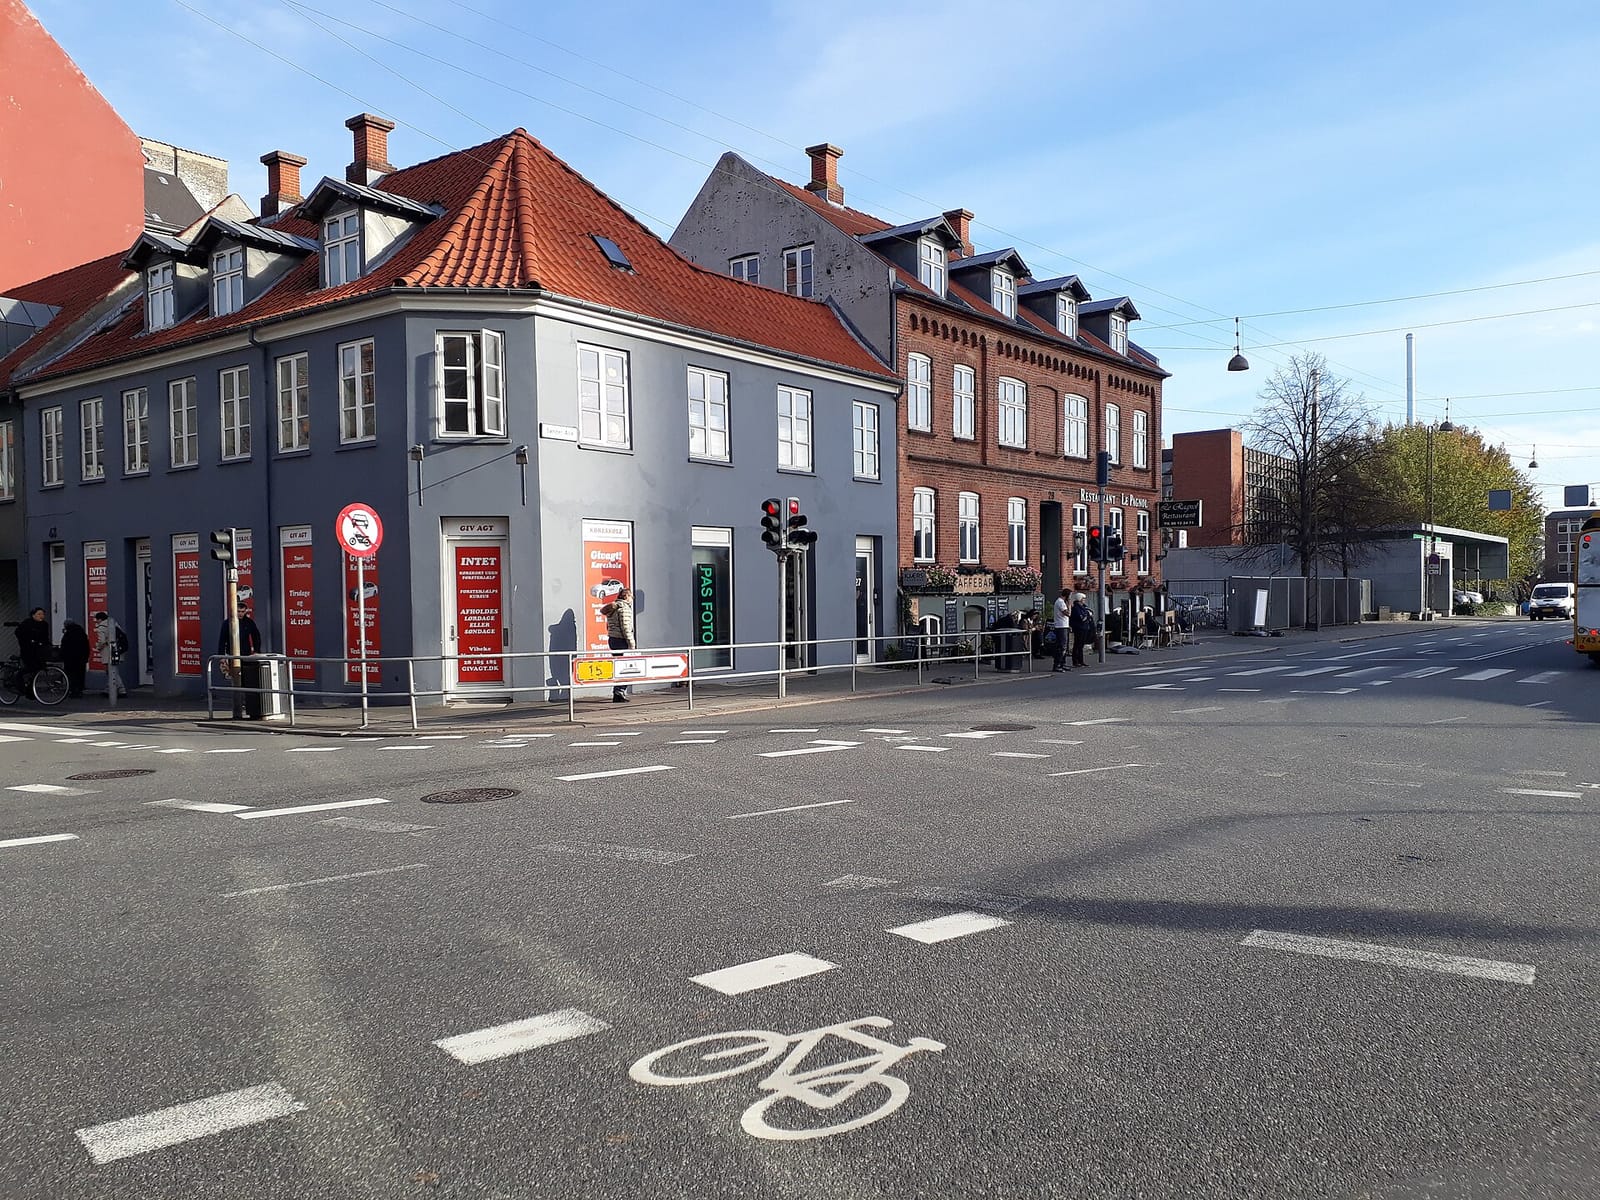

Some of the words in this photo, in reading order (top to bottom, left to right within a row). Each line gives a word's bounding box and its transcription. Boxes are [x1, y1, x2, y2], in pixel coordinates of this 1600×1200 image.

[461, 558, 497, 566] INTET
[700, 567, 713, 597] PAS
[701, 602, 714, 643] FOTO
